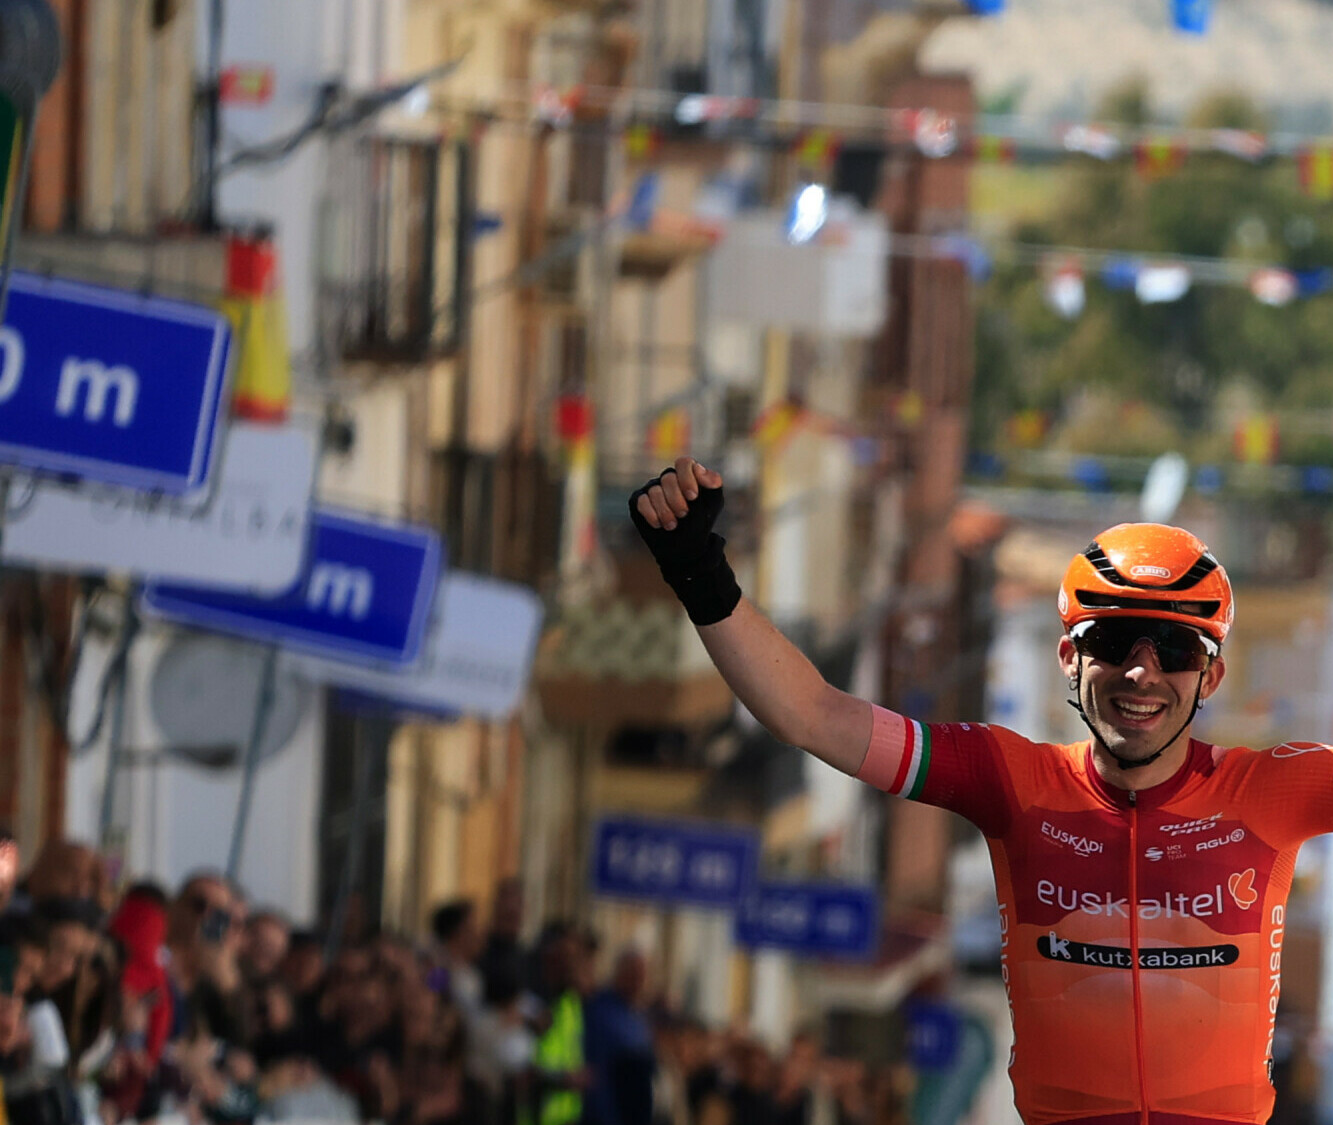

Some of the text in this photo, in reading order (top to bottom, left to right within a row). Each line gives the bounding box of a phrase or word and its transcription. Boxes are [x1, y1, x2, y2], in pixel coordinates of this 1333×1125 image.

[55, 355, 139, 428] m
[307, 560, 373, 620] m
[1159, 812, 1224, 832] QUICK
[1037, 879, 1224, 920] euskaltel
[1083, 947, 1226, 967] kutxabank
